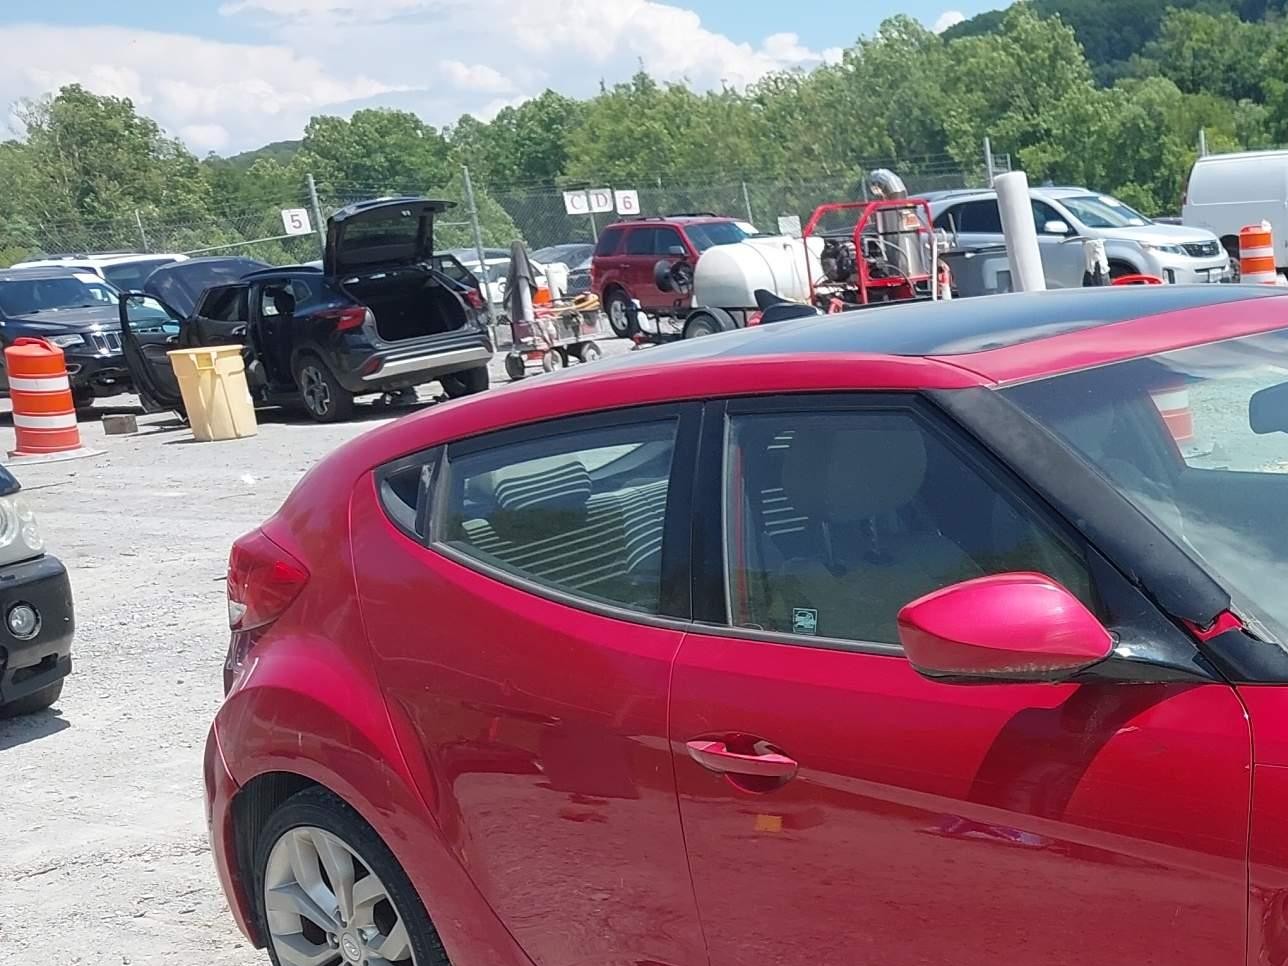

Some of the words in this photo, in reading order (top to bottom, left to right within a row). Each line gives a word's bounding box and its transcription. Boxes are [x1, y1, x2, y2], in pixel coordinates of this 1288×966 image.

[571, 194, 583, 210] C
[594, 192, 608, 208] D
[623, 195, 632, 210] 6
[290, 214, 302, 229] 5
